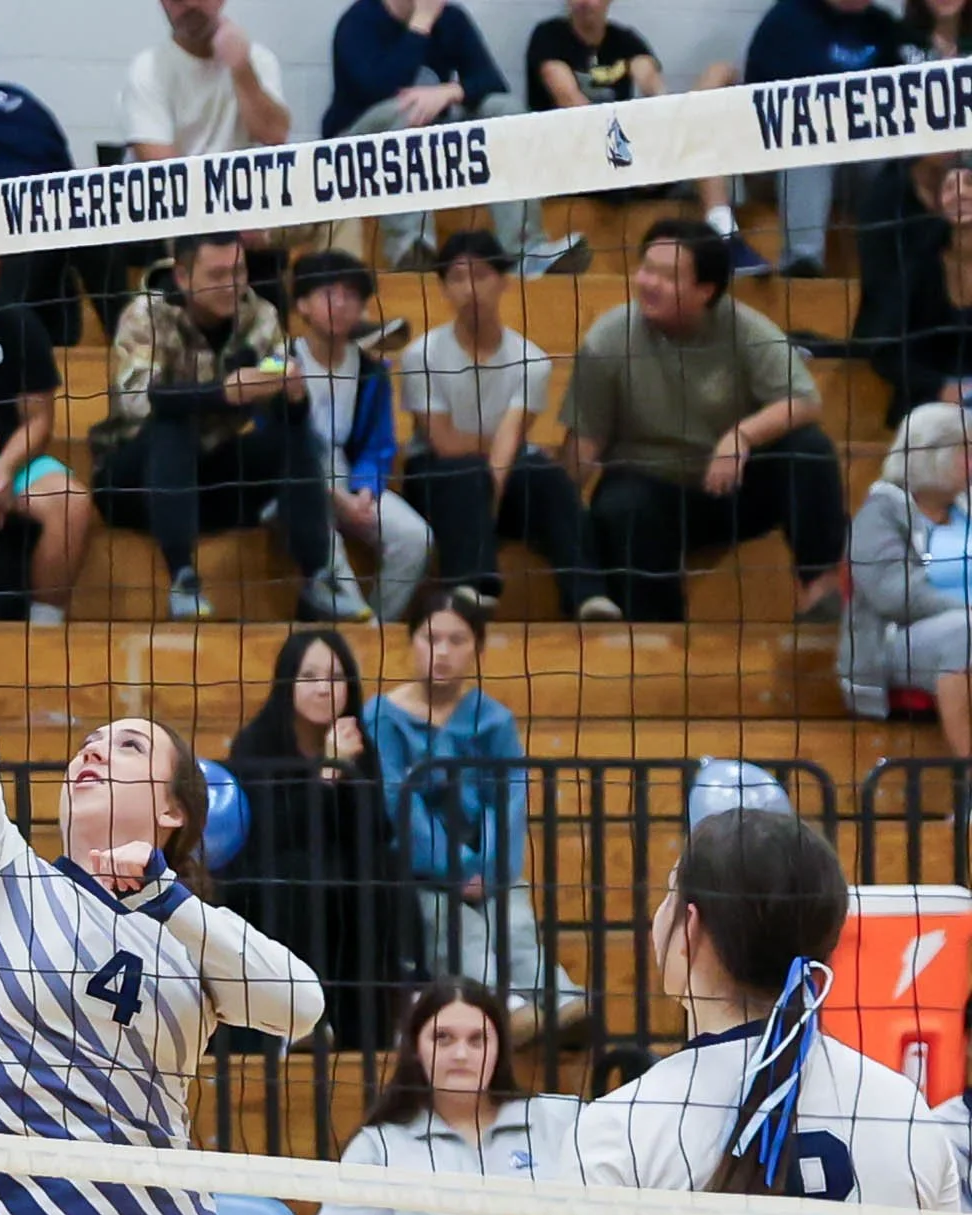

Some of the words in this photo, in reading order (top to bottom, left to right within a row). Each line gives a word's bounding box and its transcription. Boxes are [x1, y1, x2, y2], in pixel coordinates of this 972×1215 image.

[1, 162, 188, 235] WATERFORD
[204, 150, 296, 214] MOTT
[313, 127, 491, 202] CORSAIRS
[85, 949, 144, 1028] 4
